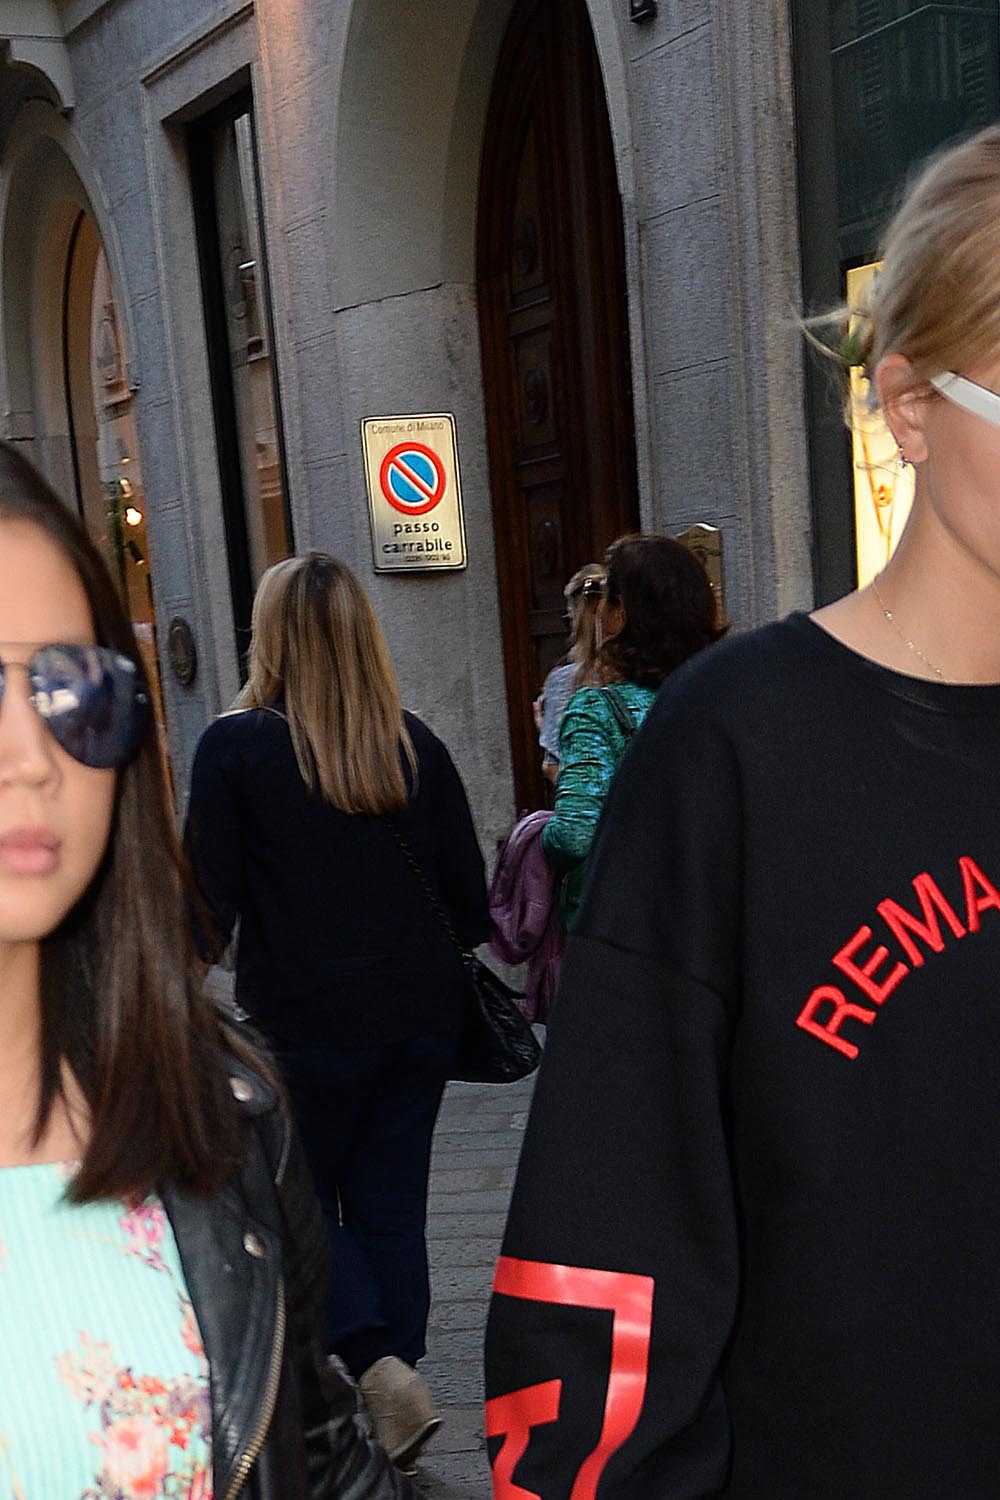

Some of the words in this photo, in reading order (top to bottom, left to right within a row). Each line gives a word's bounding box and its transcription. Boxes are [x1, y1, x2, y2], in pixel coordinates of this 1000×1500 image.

[371, 423, 404, 434] Comune
[407, 423, 415, 432] di
[416, 421, 444, 431] Milano
[393, 522, 439, 537] passo
[382, 538, 453, 554] carrabile
